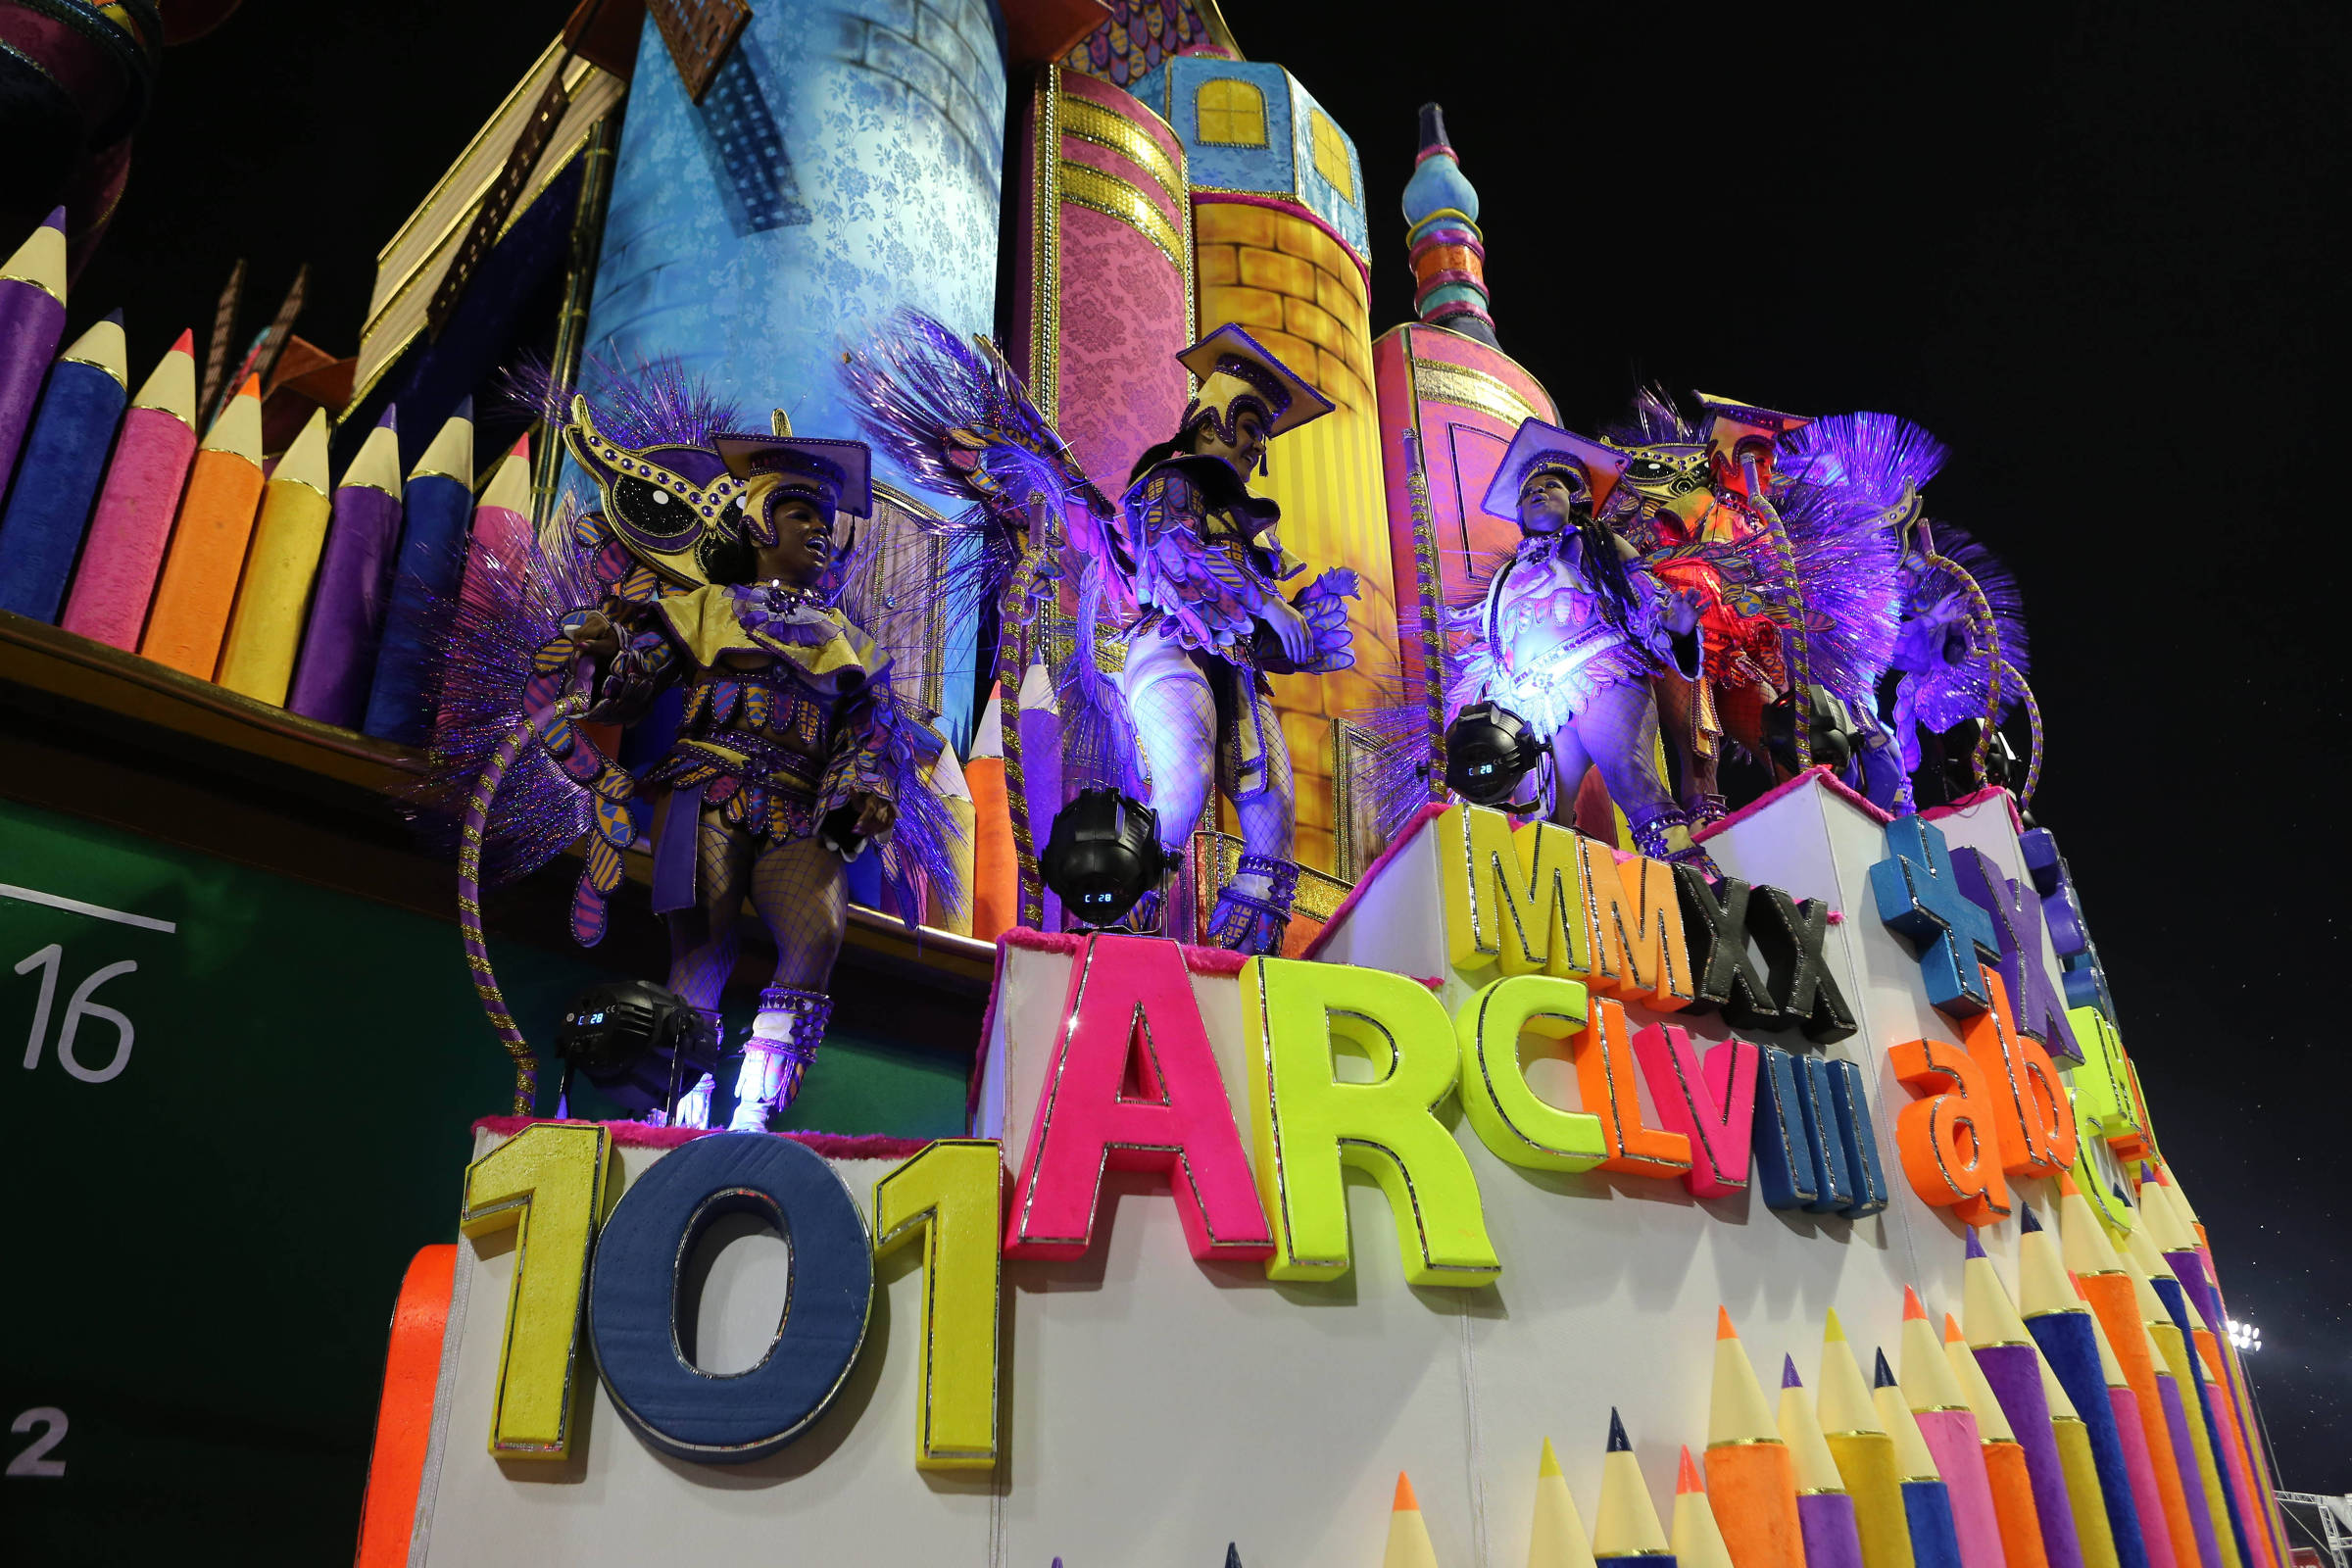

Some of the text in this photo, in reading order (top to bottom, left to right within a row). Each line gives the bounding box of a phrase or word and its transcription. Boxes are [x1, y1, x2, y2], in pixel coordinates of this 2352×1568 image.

[1480, 764, 1493, 774] 28
[1437, 803, 1858, 1045] MMXX
[14, 944, 138, 1084] 16
[590, 1012, 604, 1024] 28
[462, 1123, 1004, 1470] 101
[6, 1406, 69, 1477] 2
